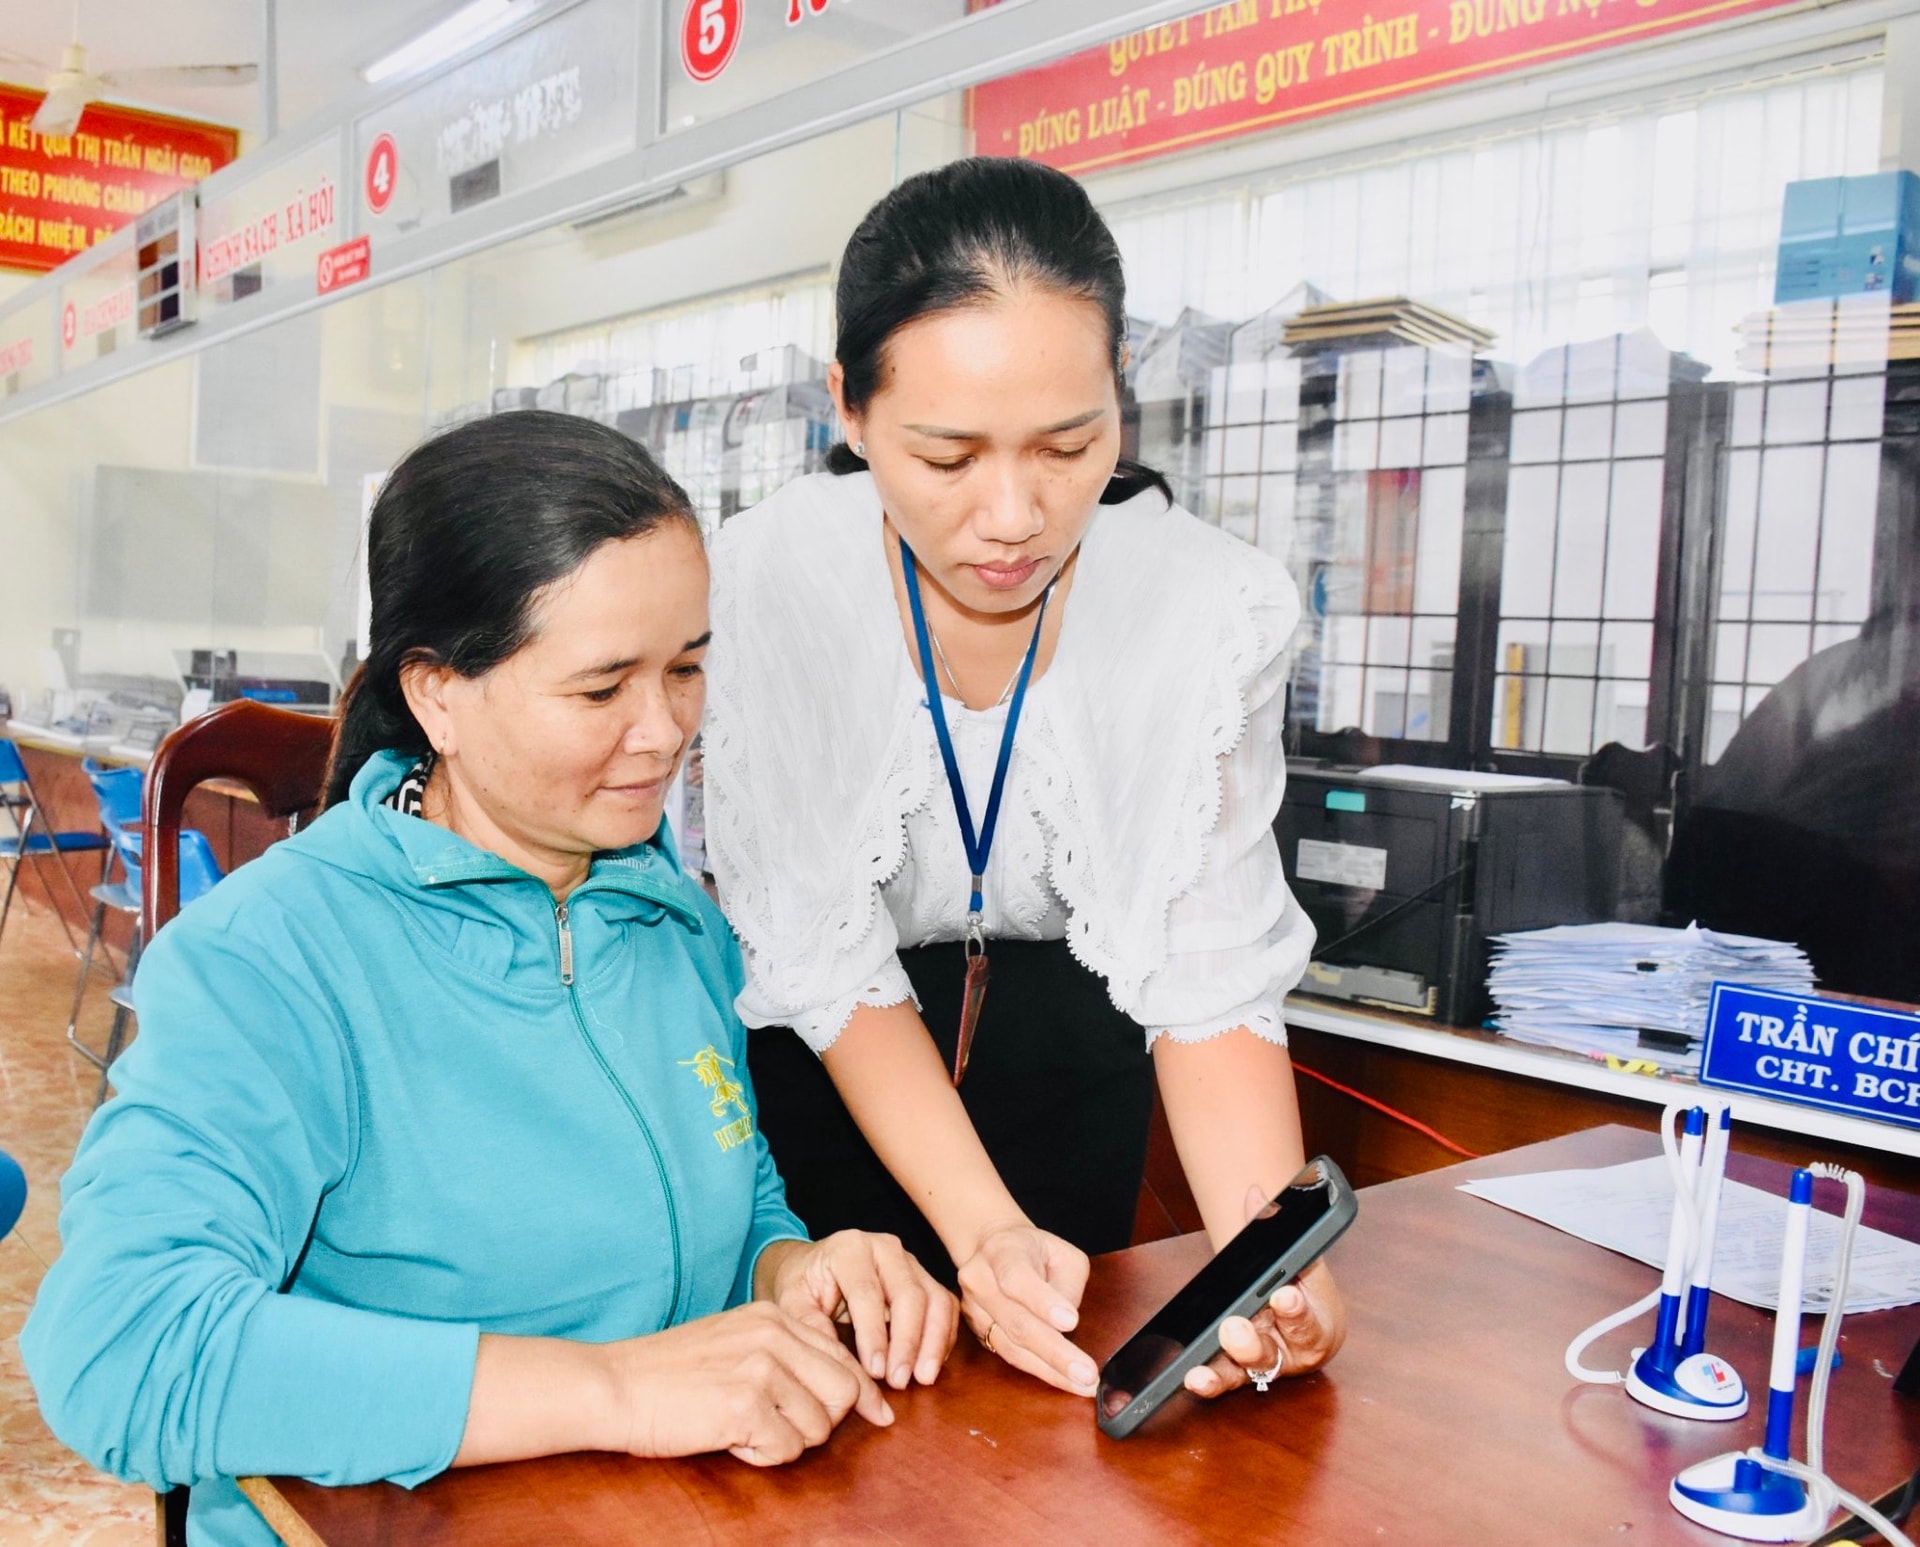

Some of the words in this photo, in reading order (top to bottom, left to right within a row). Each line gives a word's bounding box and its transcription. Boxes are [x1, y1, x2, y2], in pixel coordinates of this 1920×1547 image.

[698, 0, 726, 55] 5
[1018, 108, 1081, 158] ĐÚNG
[1087, 84, 1151, 139] LUẬT
[1172, 60, 1248, 117] ĐÚNG
[1255, 41, 1315, 105] QUY
[1321, 13, 1419, 77] TRÌNH
[0, 166, 41, 199] THEO
[373, 152, 390, 194] 4
[1736, 1004, 1839, 1057] TRẦN
[1848, 1031, 1920, 1073] CHÍ
[1755, 1055, 1840, 1092] CHT.
